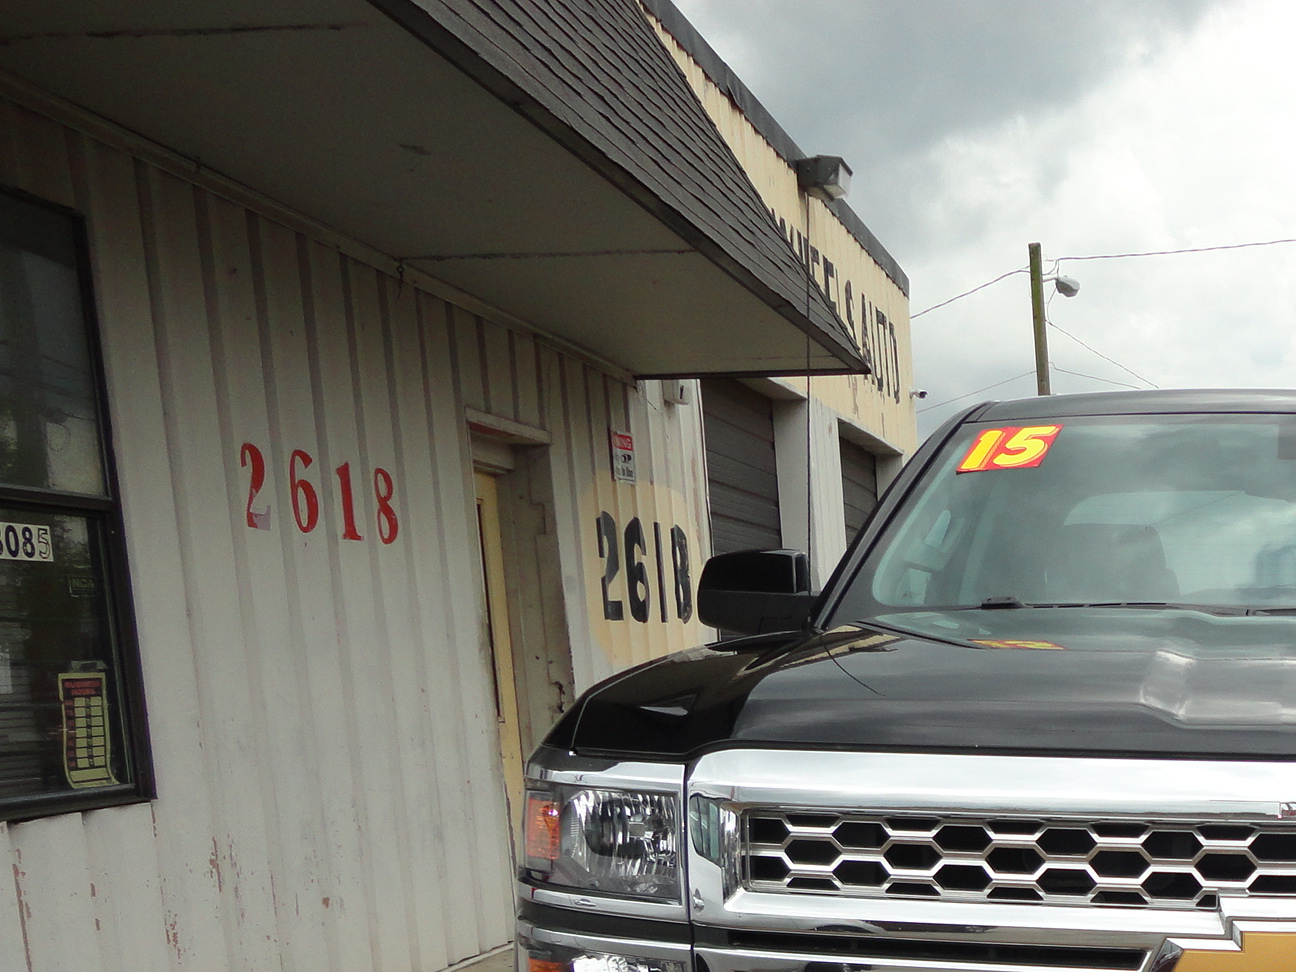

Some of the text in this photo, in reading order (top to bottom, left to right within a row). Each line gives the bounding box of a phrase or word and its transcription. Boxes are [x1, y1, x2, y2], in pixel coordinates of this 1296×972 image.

[960, 425, 1060, 469] 15
[240, 442, 399, 545] 2618
[0, 525, 50, 559] 085
